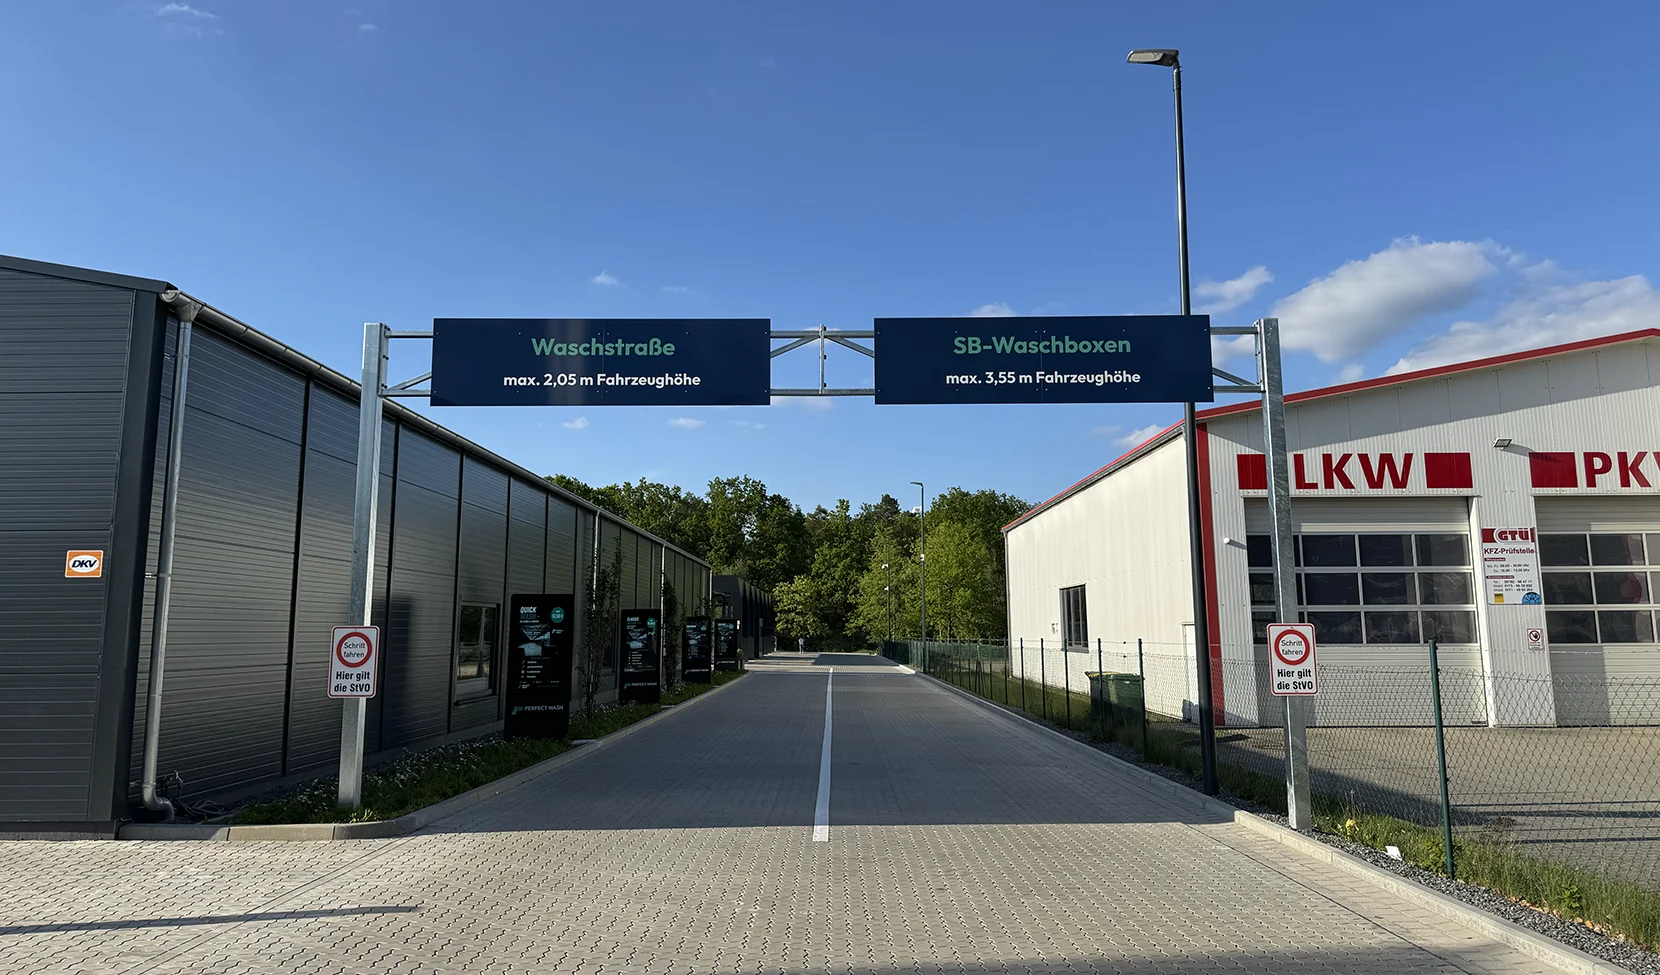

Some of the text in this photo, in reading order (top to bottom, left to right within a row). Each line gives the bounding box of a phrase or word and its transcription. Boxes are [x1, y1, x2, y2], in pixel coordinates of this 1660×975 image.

[531, 337, 675, 356] Waschstraße
[953, 335, 1131, 354] SB-Waschboxen
[503, 373, 701, 389] max. 2,05 m Fahrzeughöhe
[945, 370, 1141, 386] max. 3,55 m Fahrzeughöhe
[1293, 452, 1414, 490] LKW
[1497, 528, 1530, 541] GTÜ
[1484, 547, 1535, 555] KFZ-Prüfstelle
[71, 559, 98, 568] DKV
[519, 606, 537, 614] QUICK
[336, 671, 370, 681] Hier gilt
[1277, 669, 1312, 679] Hier gilt
[334, 683, 371, 692] die StVO
[1277, 681, 1313, 690] die StVO
